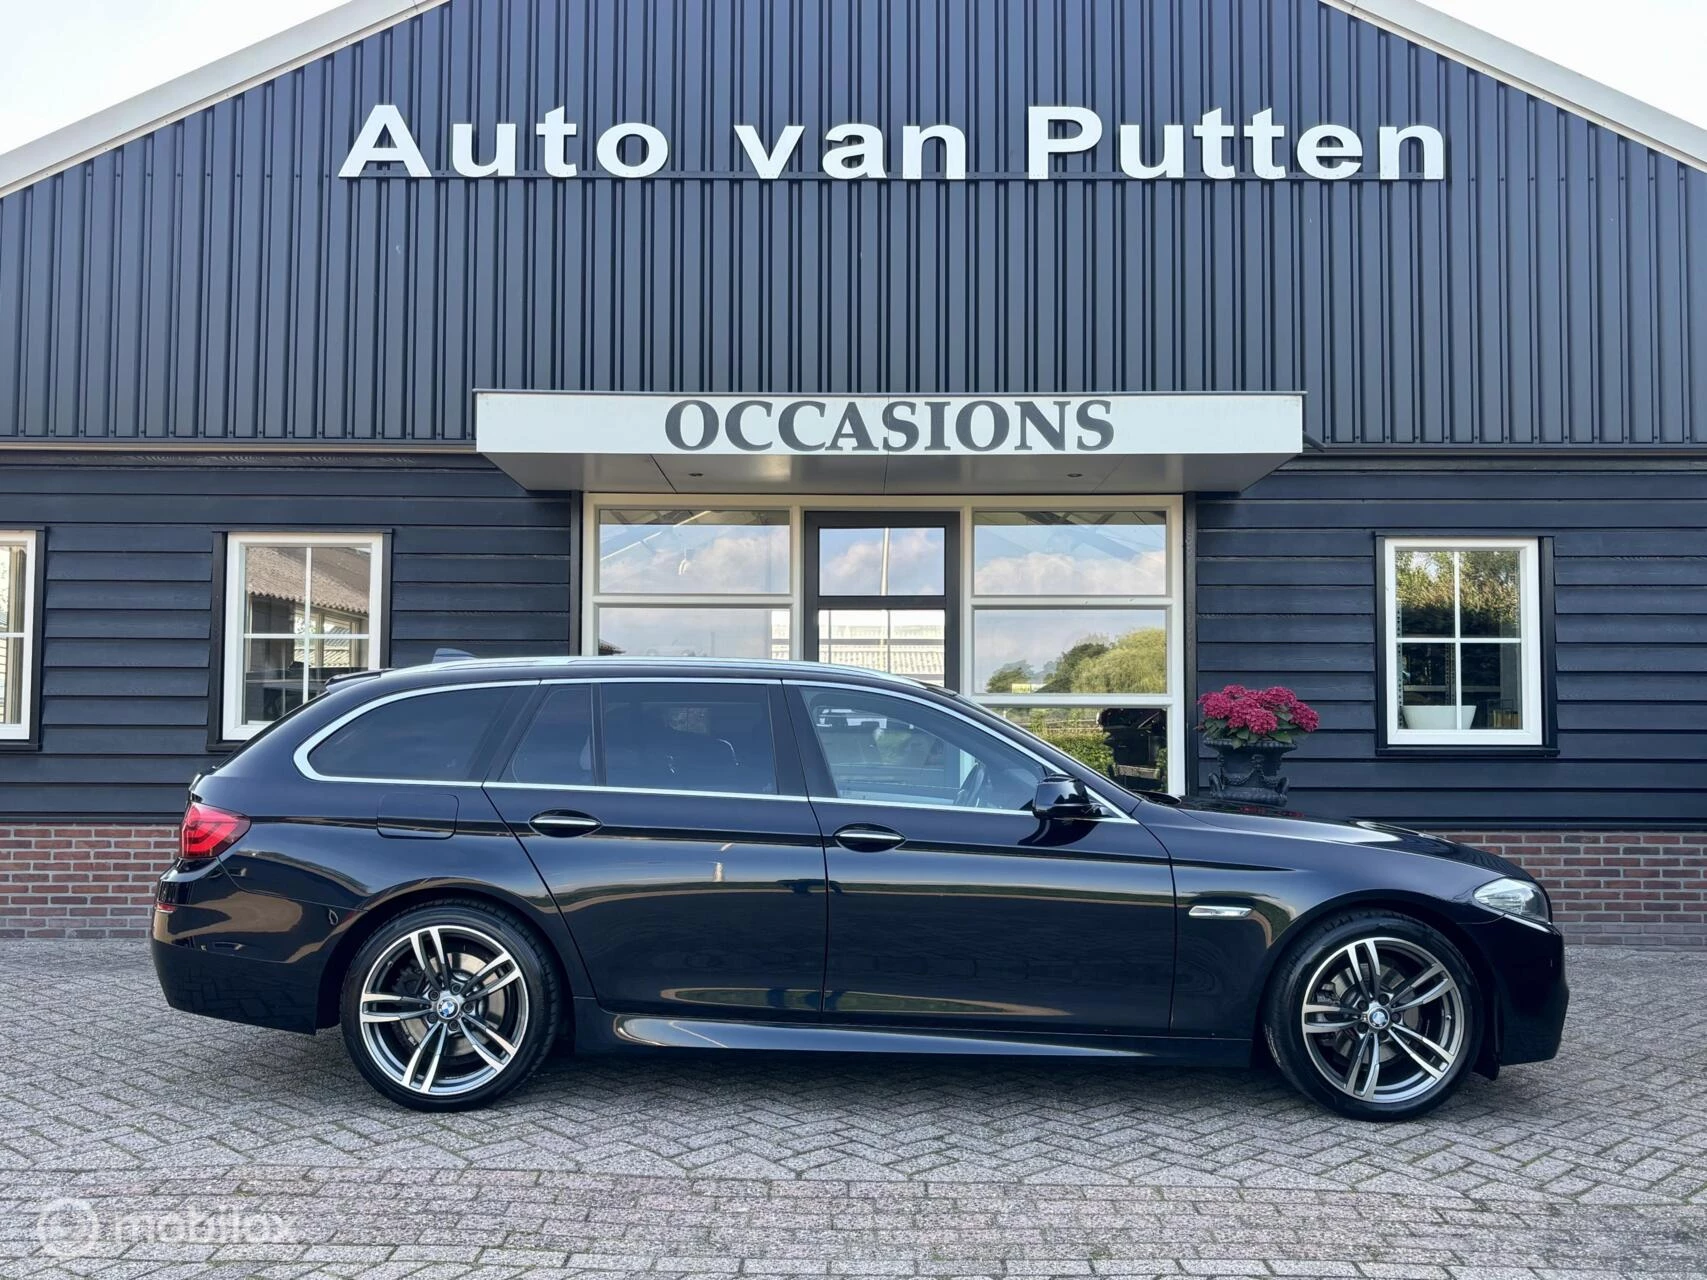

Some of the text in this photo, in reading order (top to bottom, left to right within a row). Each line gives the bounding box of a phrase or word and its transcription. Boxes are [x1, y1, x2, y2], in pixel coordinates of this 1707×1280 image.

[337, 104, 1445, 181] Auto van Putten
[664, 399, 1115, 452] OCCASIONS
